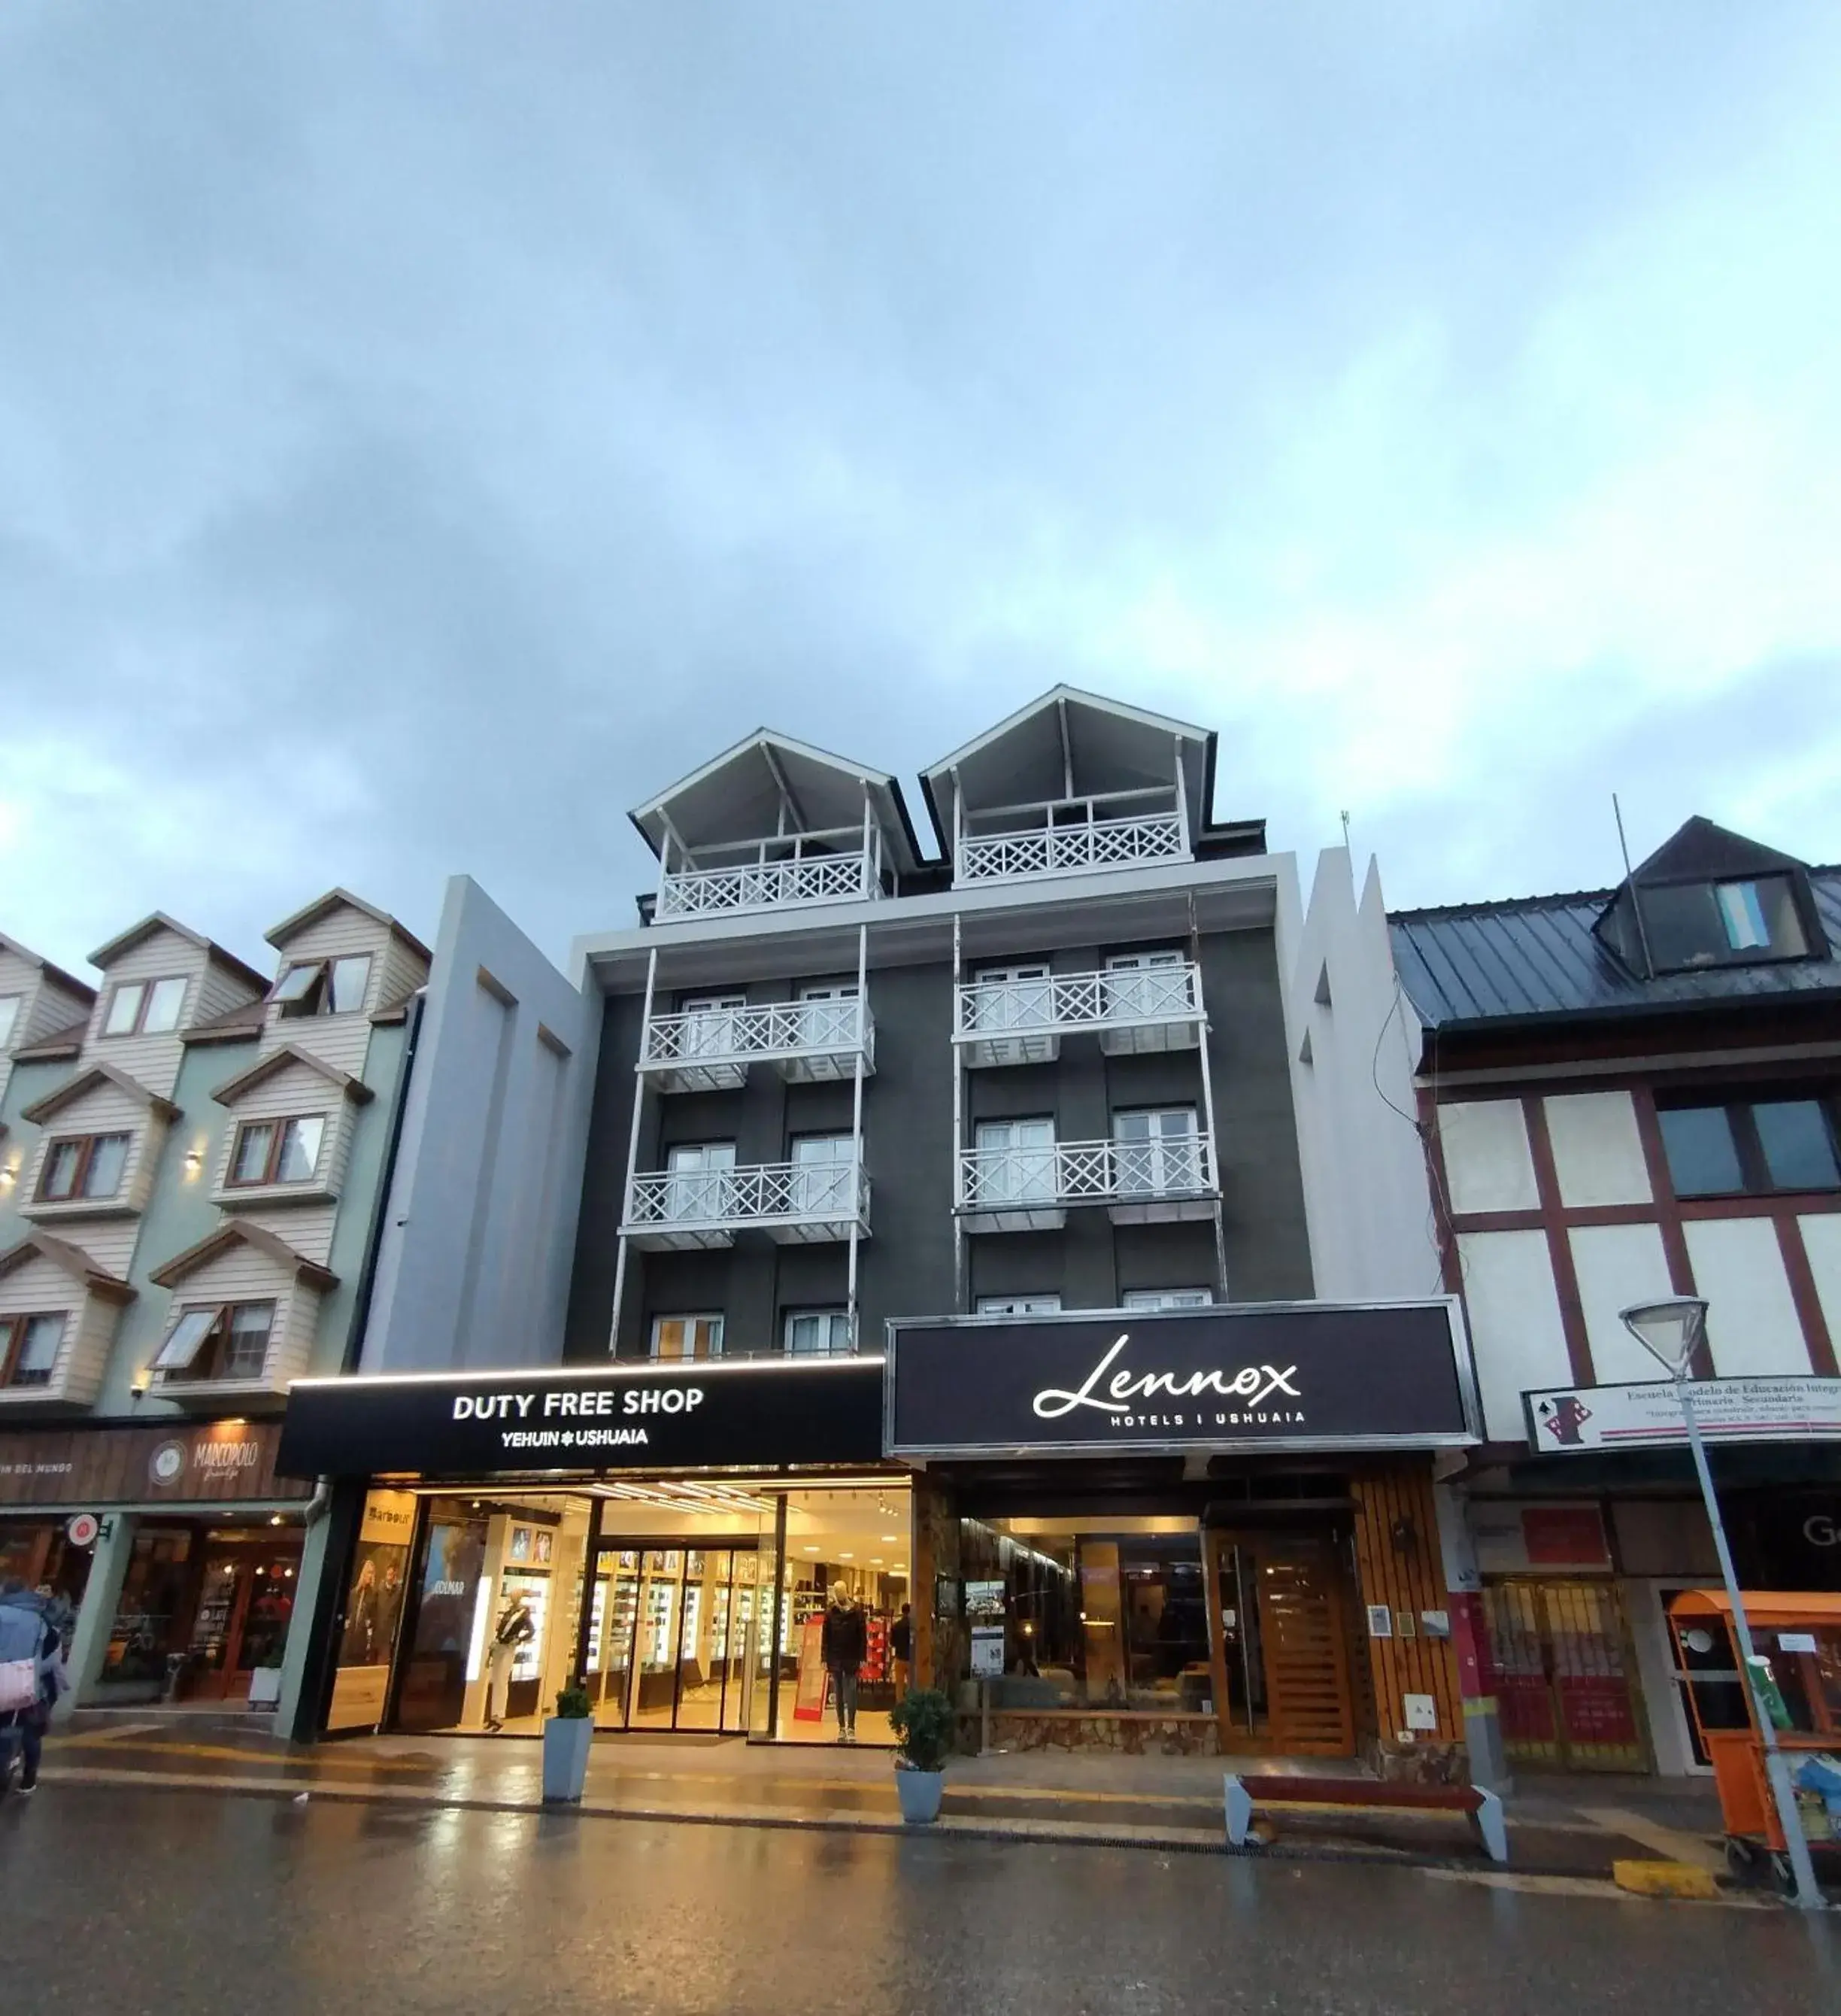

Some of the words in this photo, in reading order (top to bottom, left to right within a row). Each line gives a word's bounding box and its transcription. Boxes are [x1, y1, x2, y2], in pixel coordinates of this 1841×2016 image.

[1033, 1334, 1302, 1419] Lennox
[1627, 1389, 1674, 1401] Escuela
[1686, 1384, 1722, 1395] odelo
[1724, 1385, 1739, 1395] de
[1691, 1396, 1733, 1407] rimaria
[453, 1395, 535, 1420] DUTY
[544, 1392, 614, 1416] FREE
[623, 1388, 704, 1414] SHOP
[1111, 1415, 1183, 1427] HOTELS
[1215, 1411, 1306, 1424] USHUAIA
[502, 1431, 560, 1448] YEHUIN
[575, 1429, 648, 1446] USHUAIA
[193, 1441, 259, 1467] MARCOPOLO
[35, 1462, 73, 1474] MUNDO
